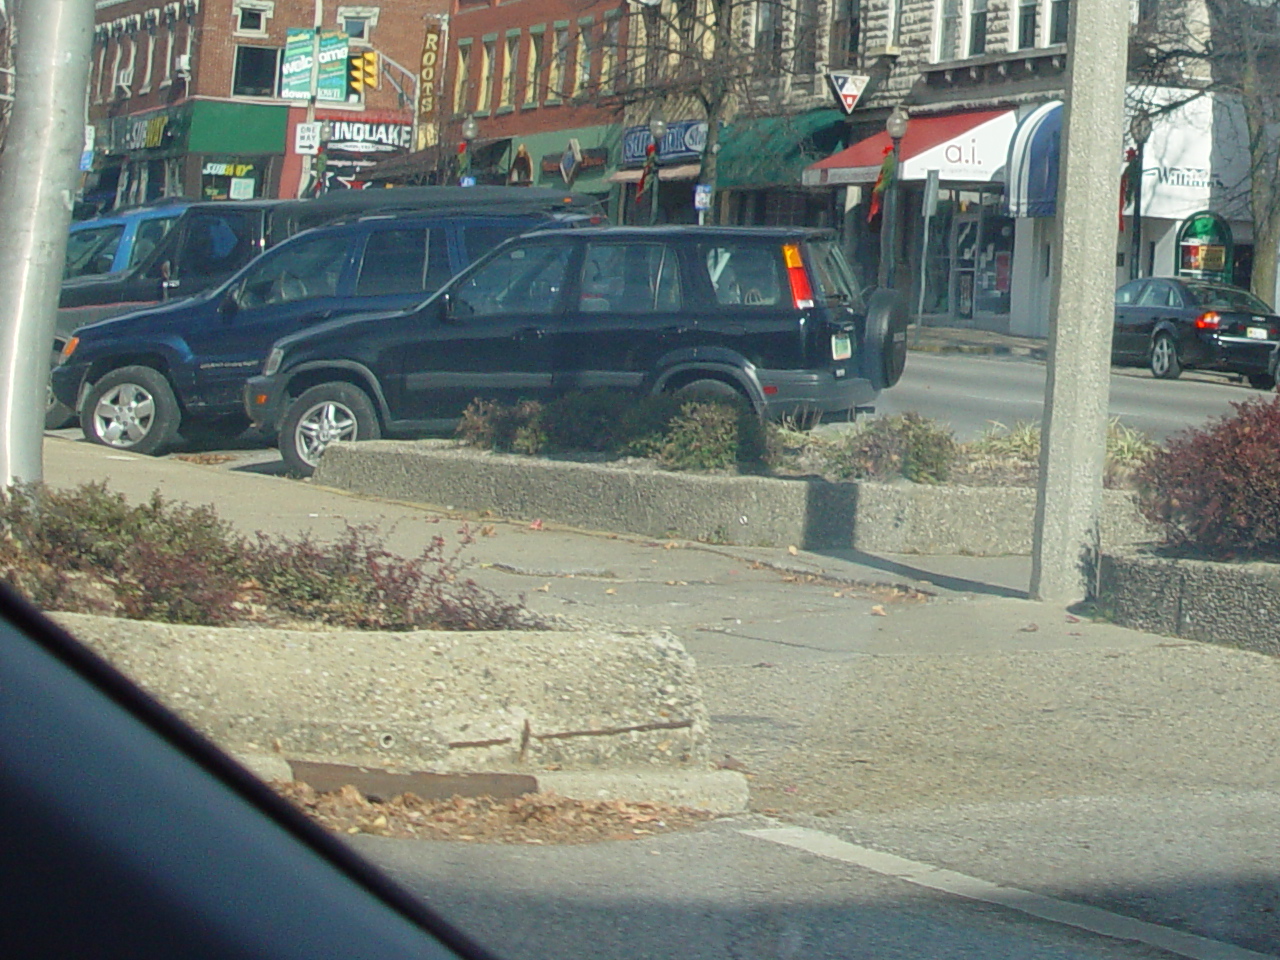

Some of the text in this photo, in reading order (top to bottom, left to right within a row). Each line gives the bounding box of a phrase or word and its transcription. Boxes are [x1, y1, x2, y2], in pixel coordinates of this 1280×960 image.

[421, 33, 439, 114] ROOTS
[300, 126, 316, 134] ONE
[300, 134, 317, 142] WAY
